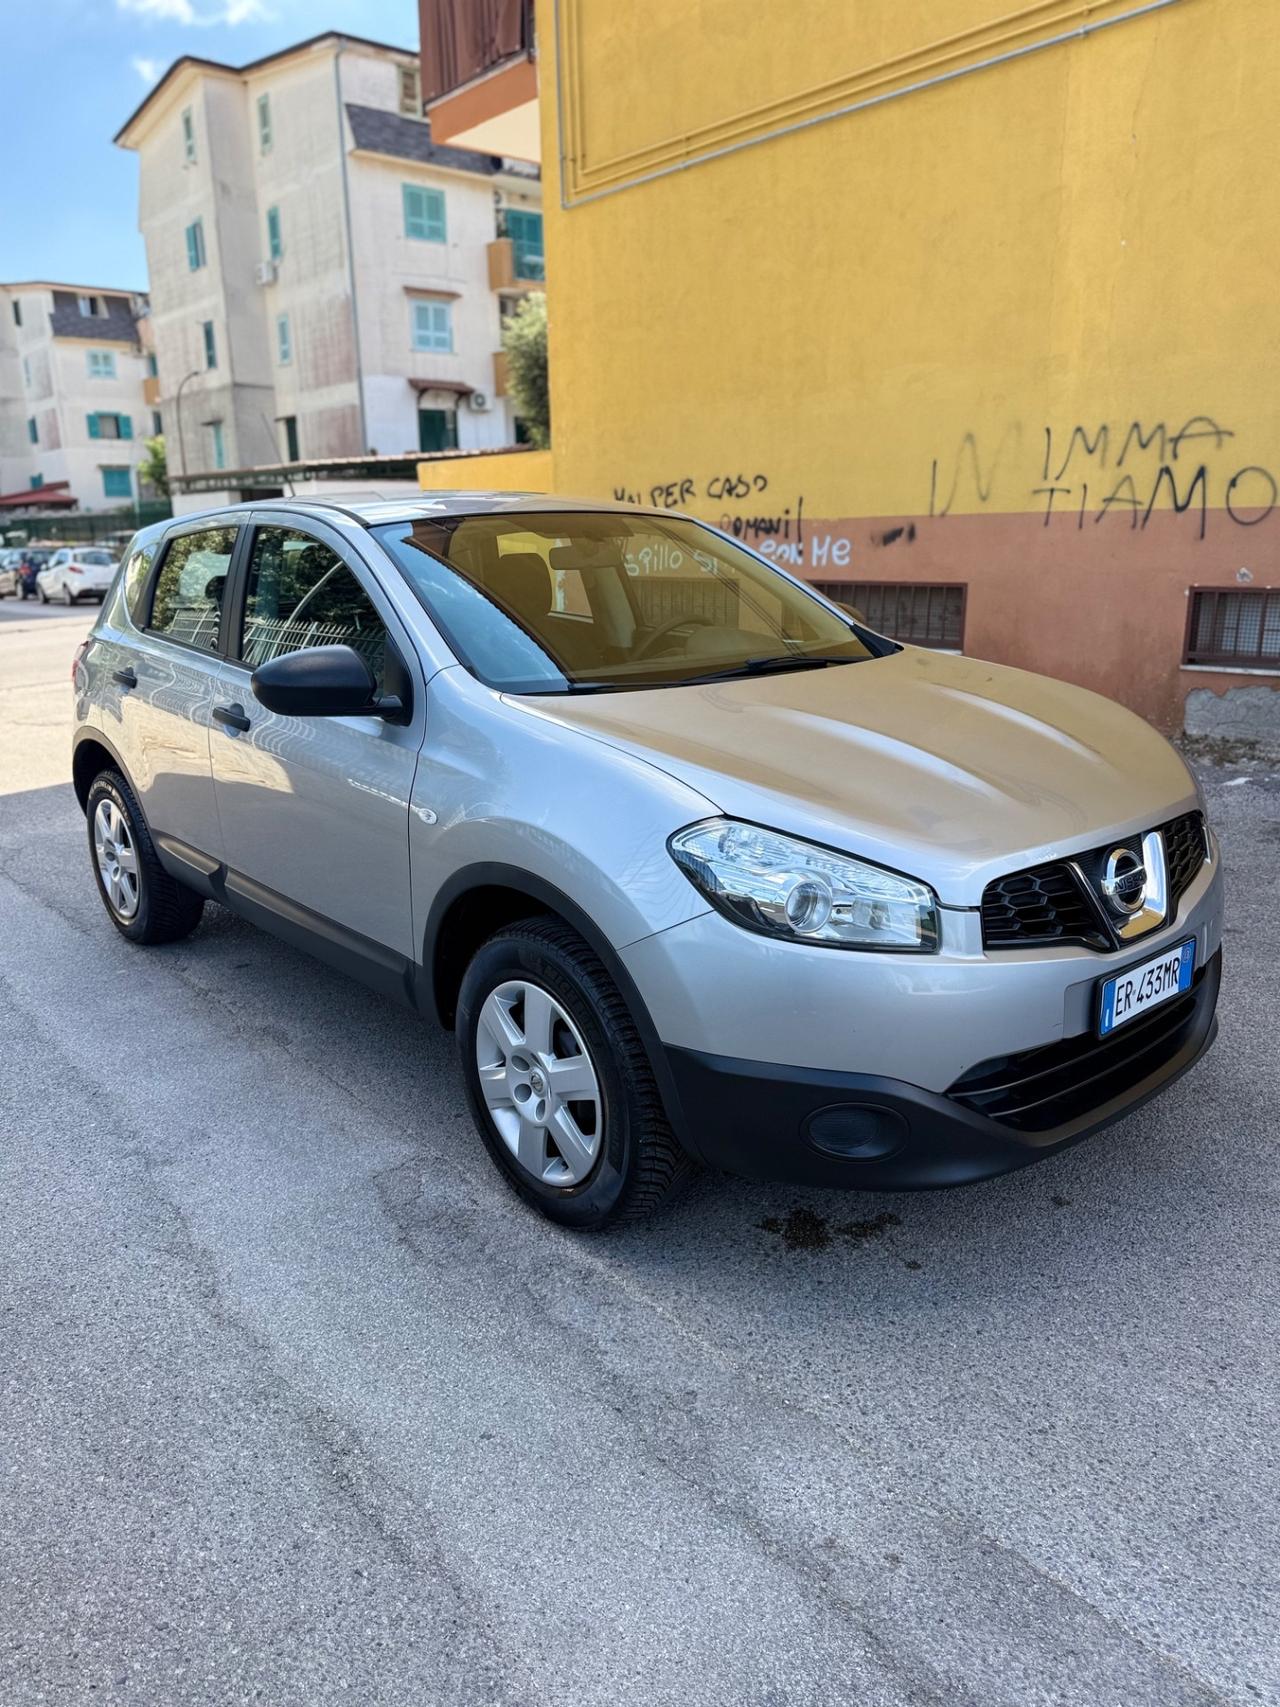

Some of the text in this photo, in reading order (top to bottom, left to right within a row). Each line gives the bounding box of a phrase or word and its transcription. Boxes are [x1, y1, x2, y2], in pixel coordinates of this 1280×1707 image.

[1043, 416, 1235, 481] IMMA
[650, 478, 698, 508] PER
[706, 474, 768, 500] CASO
